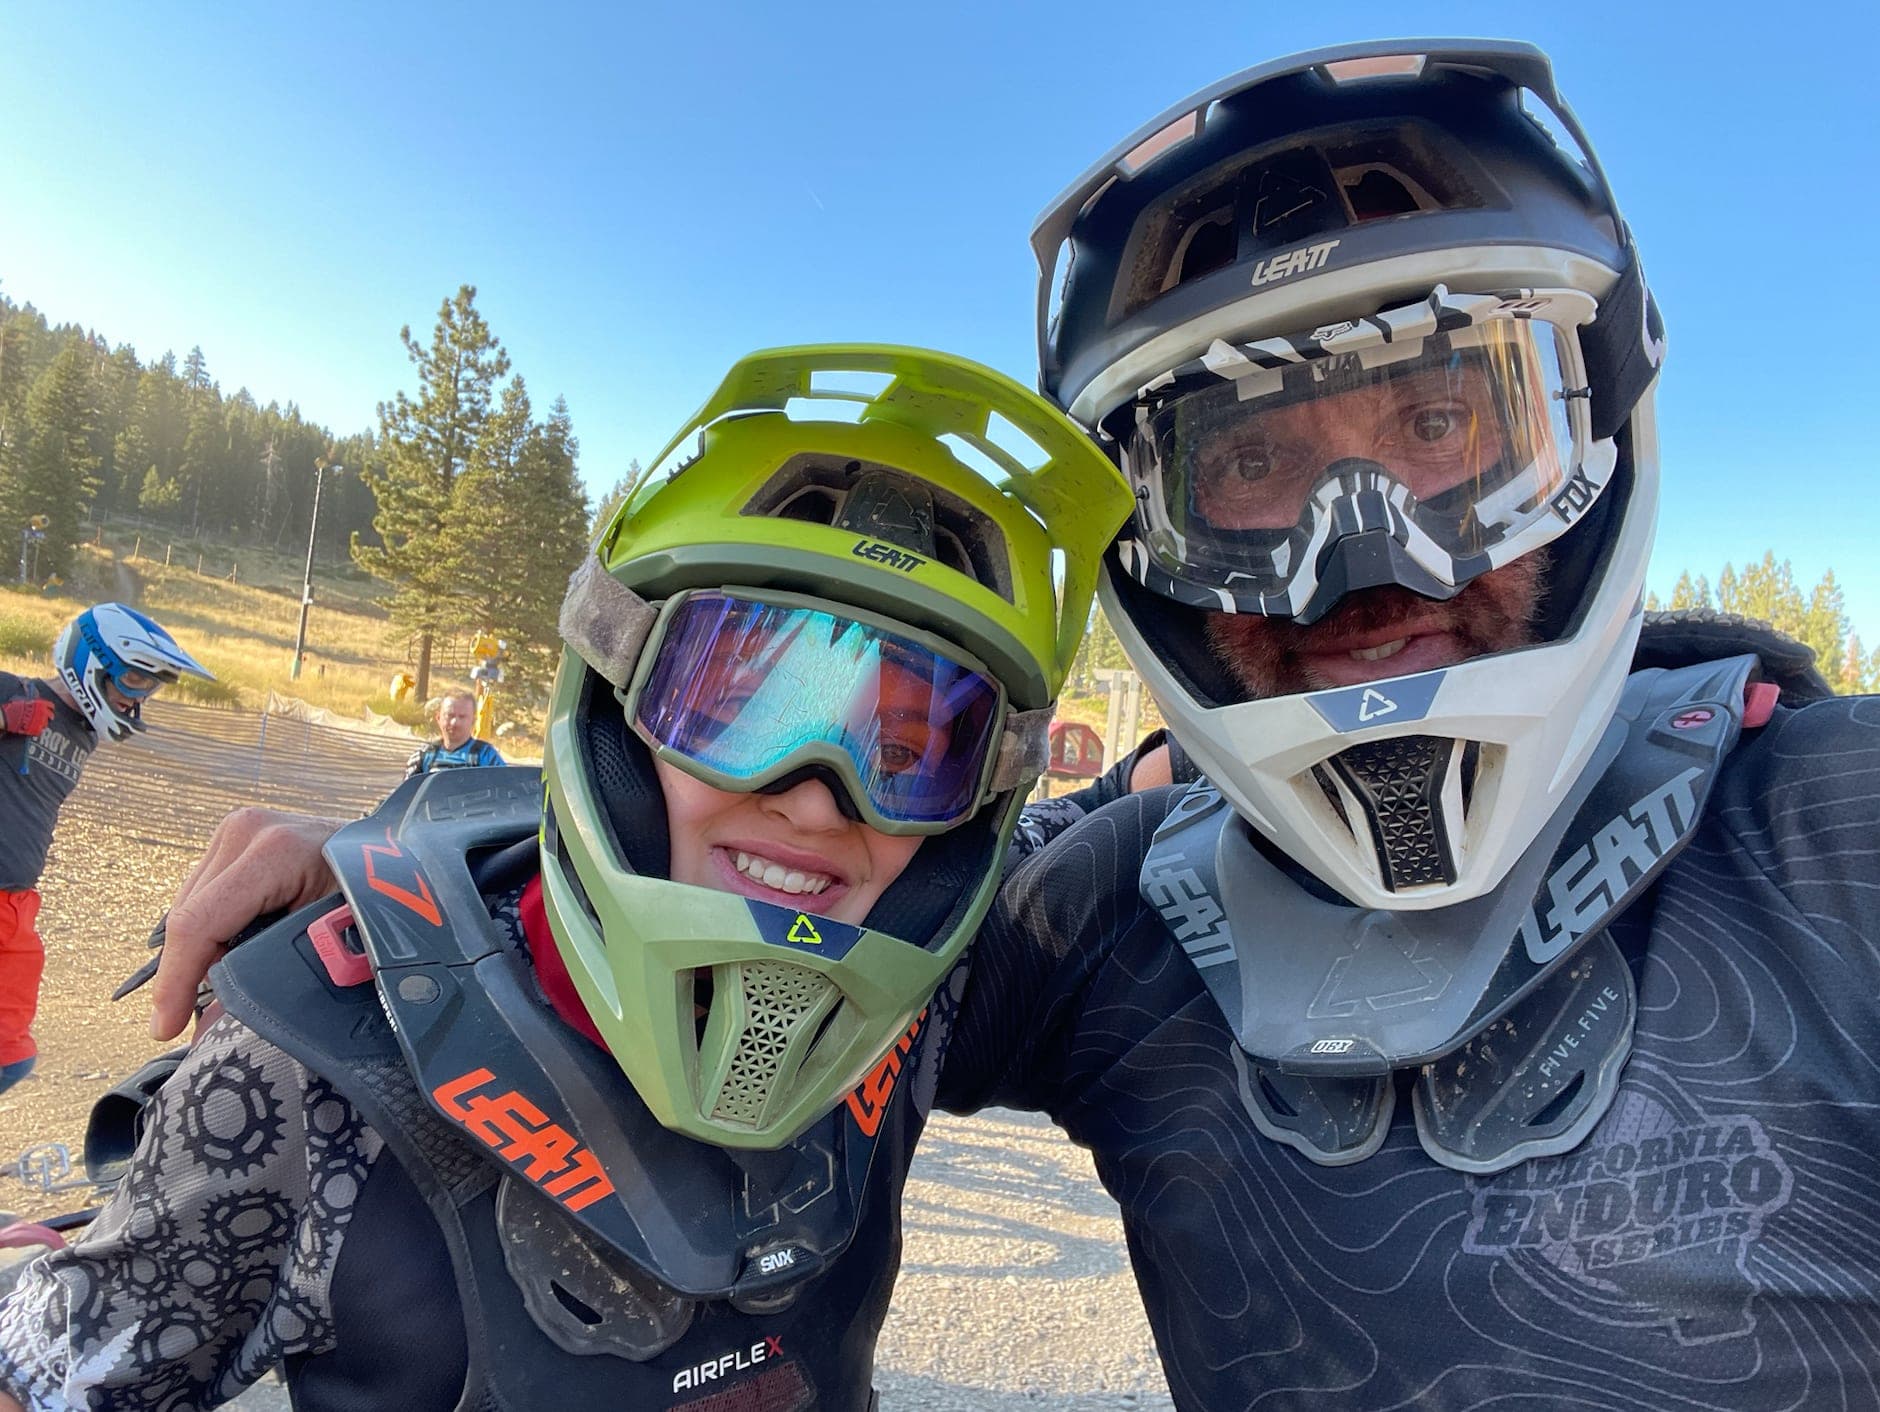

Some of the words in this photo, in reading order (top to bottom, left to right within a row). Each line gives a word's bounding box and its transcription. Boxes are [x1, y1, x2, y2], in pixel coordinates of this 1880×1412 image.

[1251, 239, 1340, 286] LEATT
[1551, 463, 1600, 523] FOX
[852, 540, 927, 573] LEATT
[65, 668, 96, 712] GIRO
[33, 727, 70, 756] ROY
[1520, 766, 1704, 964] LEATT
[1140, 852, 1240, 969] LEATT
[432, 1067, 615, 1213] LEATT
[1473, 1154, 1784, 1247] ENDURO
[1592, 1214, 1750, 1262] SERIES
[673, 1335, 784, 1394] AIRFLEX
